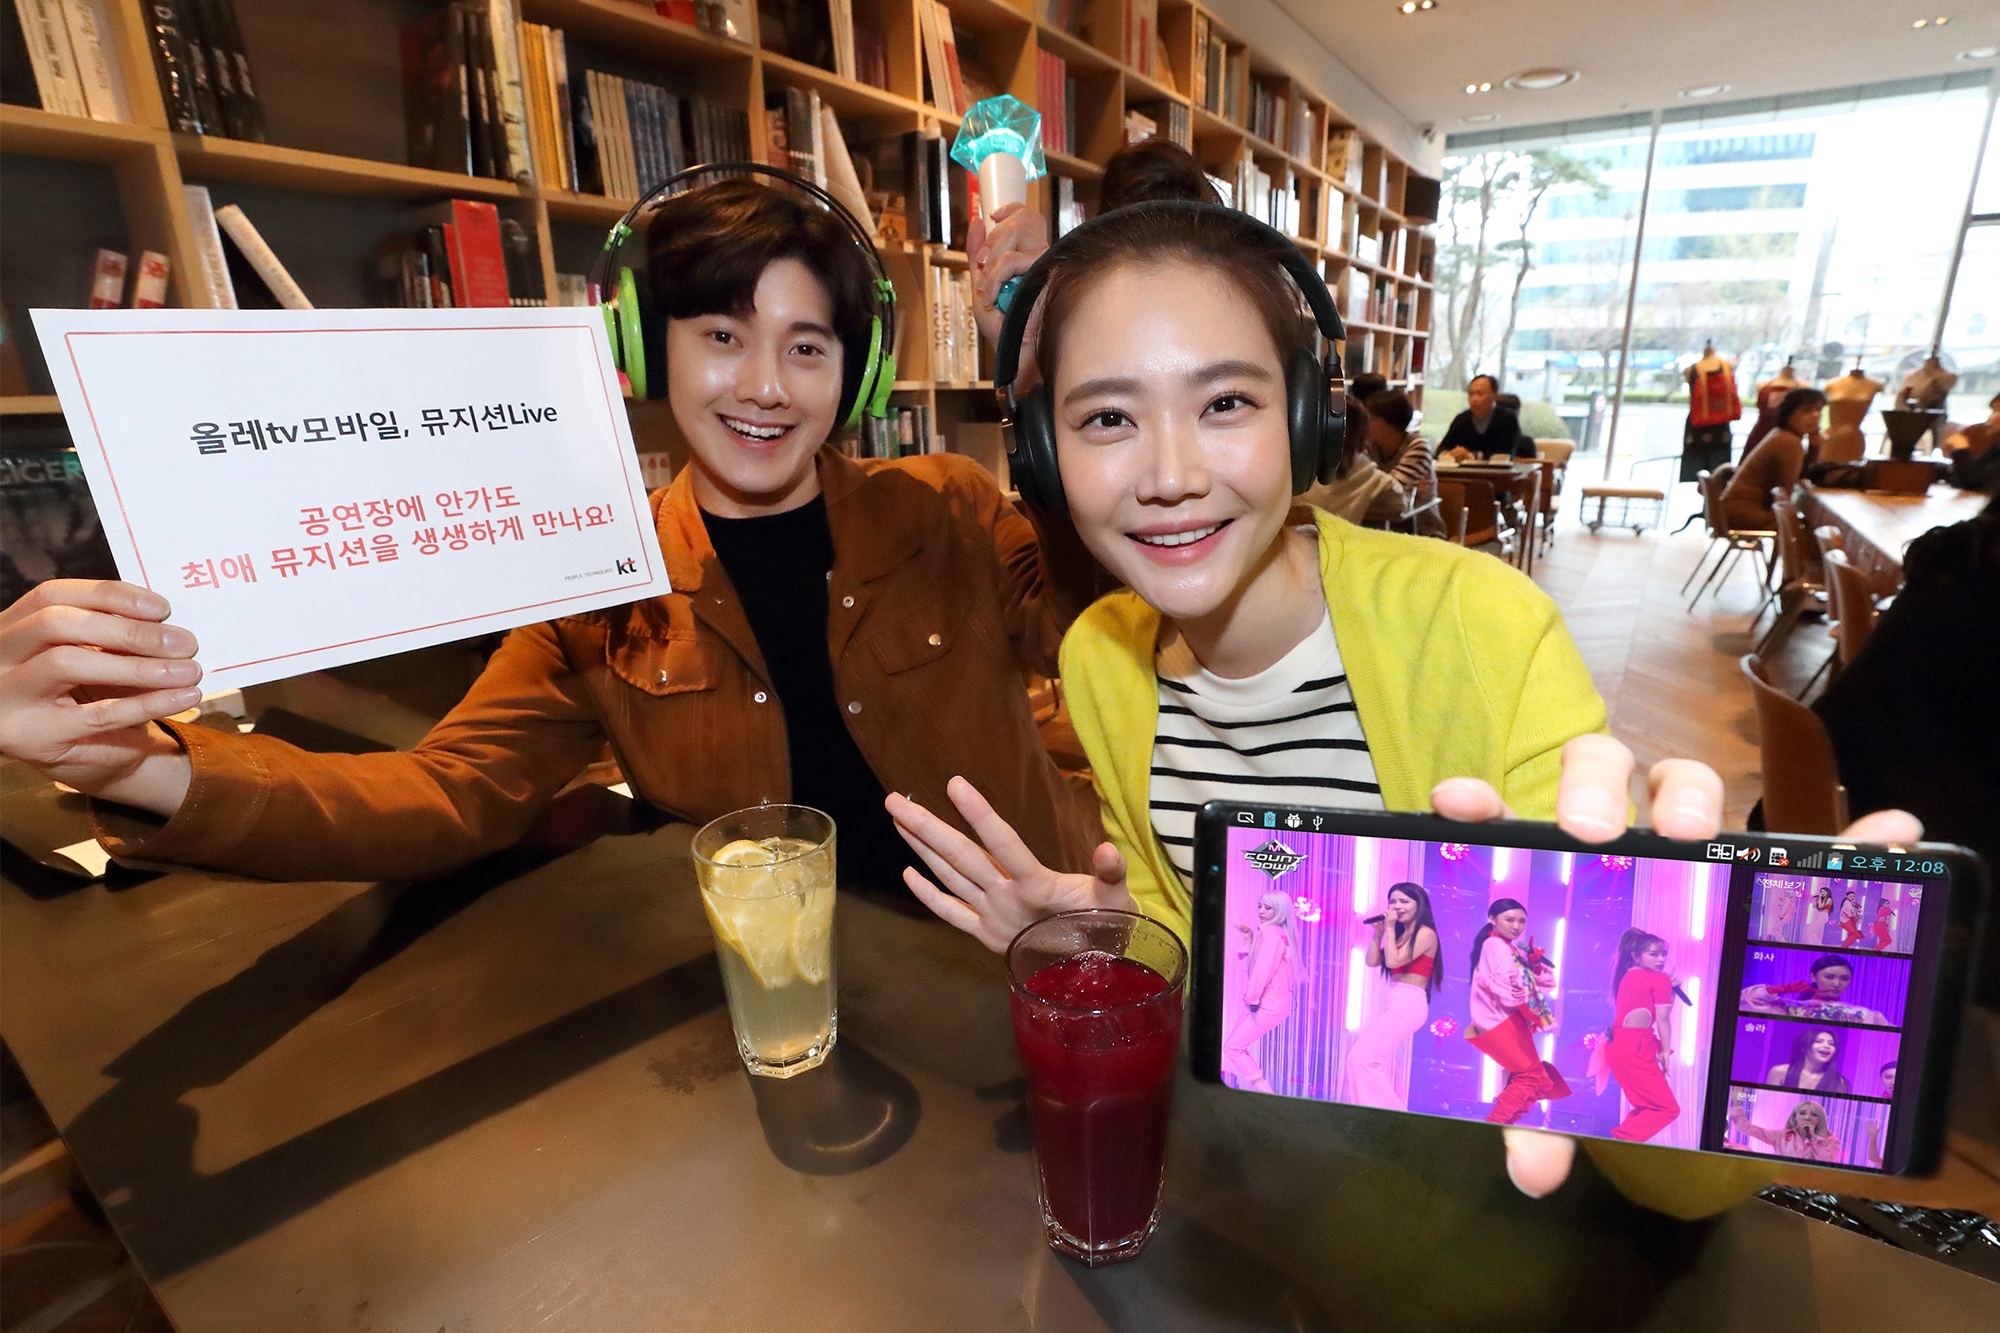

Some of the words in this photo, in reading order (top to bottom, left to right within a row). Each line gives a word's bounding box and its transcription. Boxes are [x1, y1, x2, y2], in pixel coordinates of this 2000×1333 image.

[189, 410, 409, 455] 올레tv모바일,
[420, 402, 558, 436] 뮤지션Live
[299, 495, 427, 536] 공연장에
[435, 485, 521, 518] 안가도
[180, 552, 258, 588] 최애
[271, 533, 399, 578] 뮤지션을
[411, 515, 525, 555] 생생하게
[532, 503, 615, 537] 만나요!
[615, 557, 637, 575] kt
[1244, 852, 1307, 864] COUNT
[1850, 855, 1887, 872] 오후
[1894, 858, 1945, 875] 12:08
[1251, 862, 1298, 872] DOWN
[1762, 878, 1806, 891] 전체보기
[1752, 951, 1775, 962] 화사
[1744, 1022, 1766, 1034] 솔라
